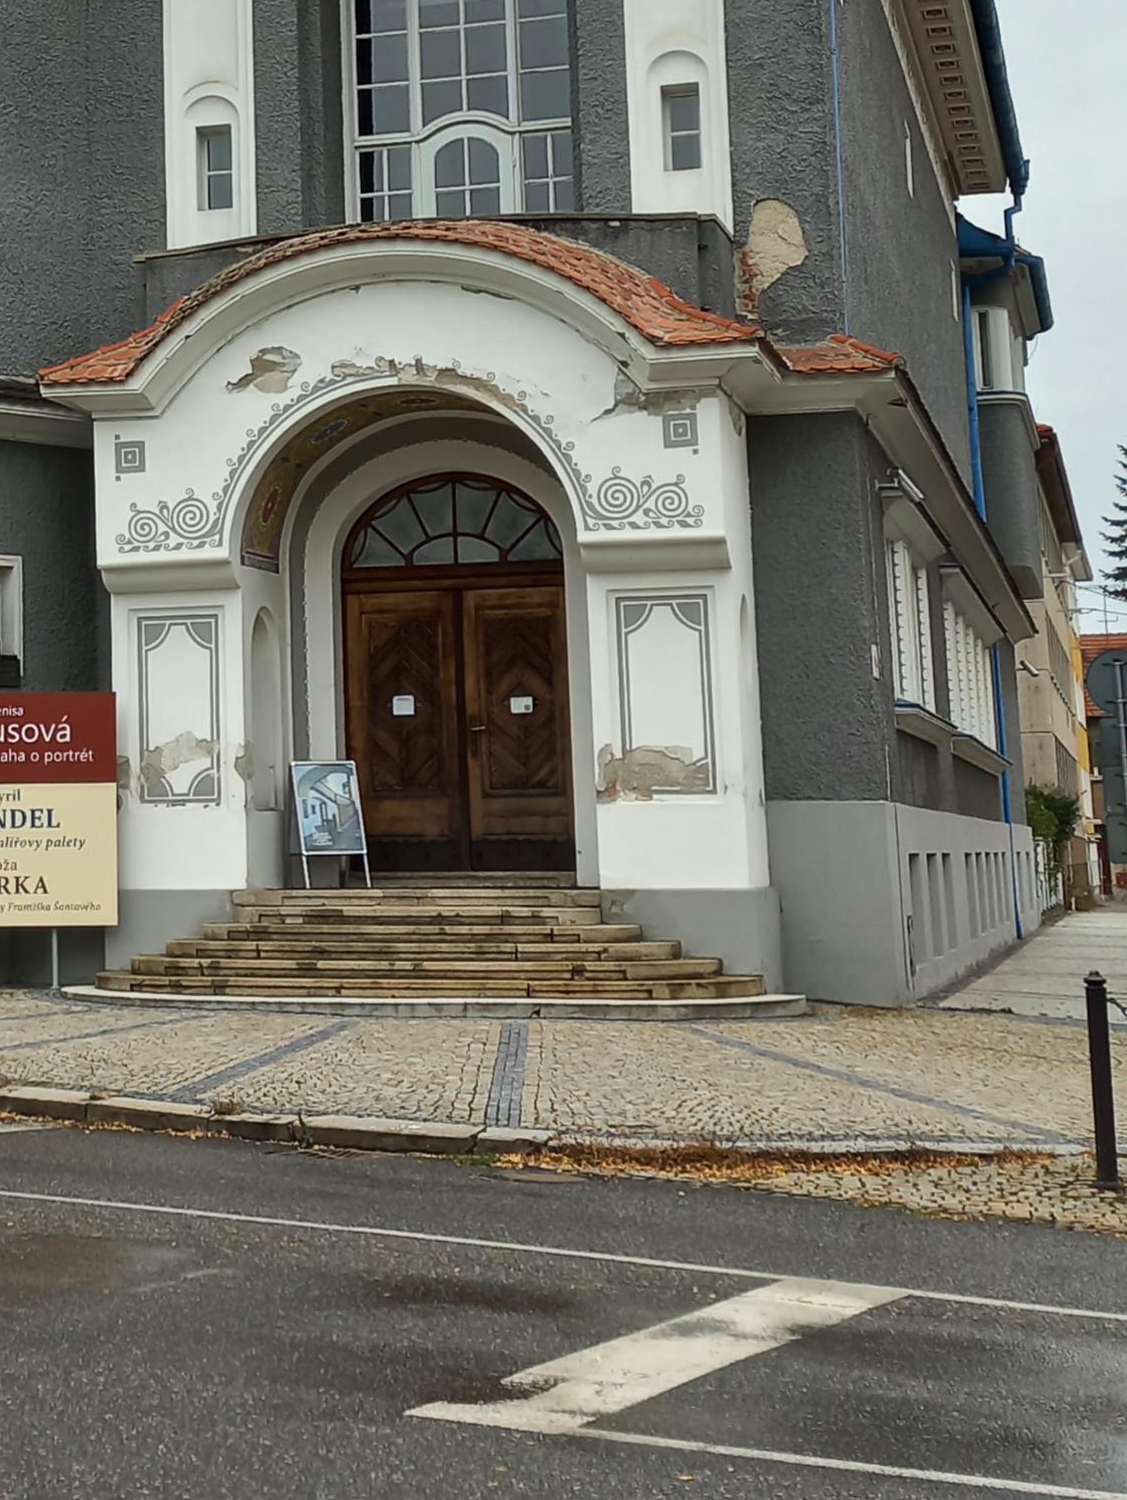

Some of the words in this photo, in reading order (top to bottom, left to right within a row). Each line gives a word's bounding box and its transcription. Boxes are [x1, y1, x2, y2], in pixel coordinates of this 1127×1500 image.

[30, 753, 40, 763] o
[44, 749, 95, 765] portrét
[45, 835, 86, 851] palety
